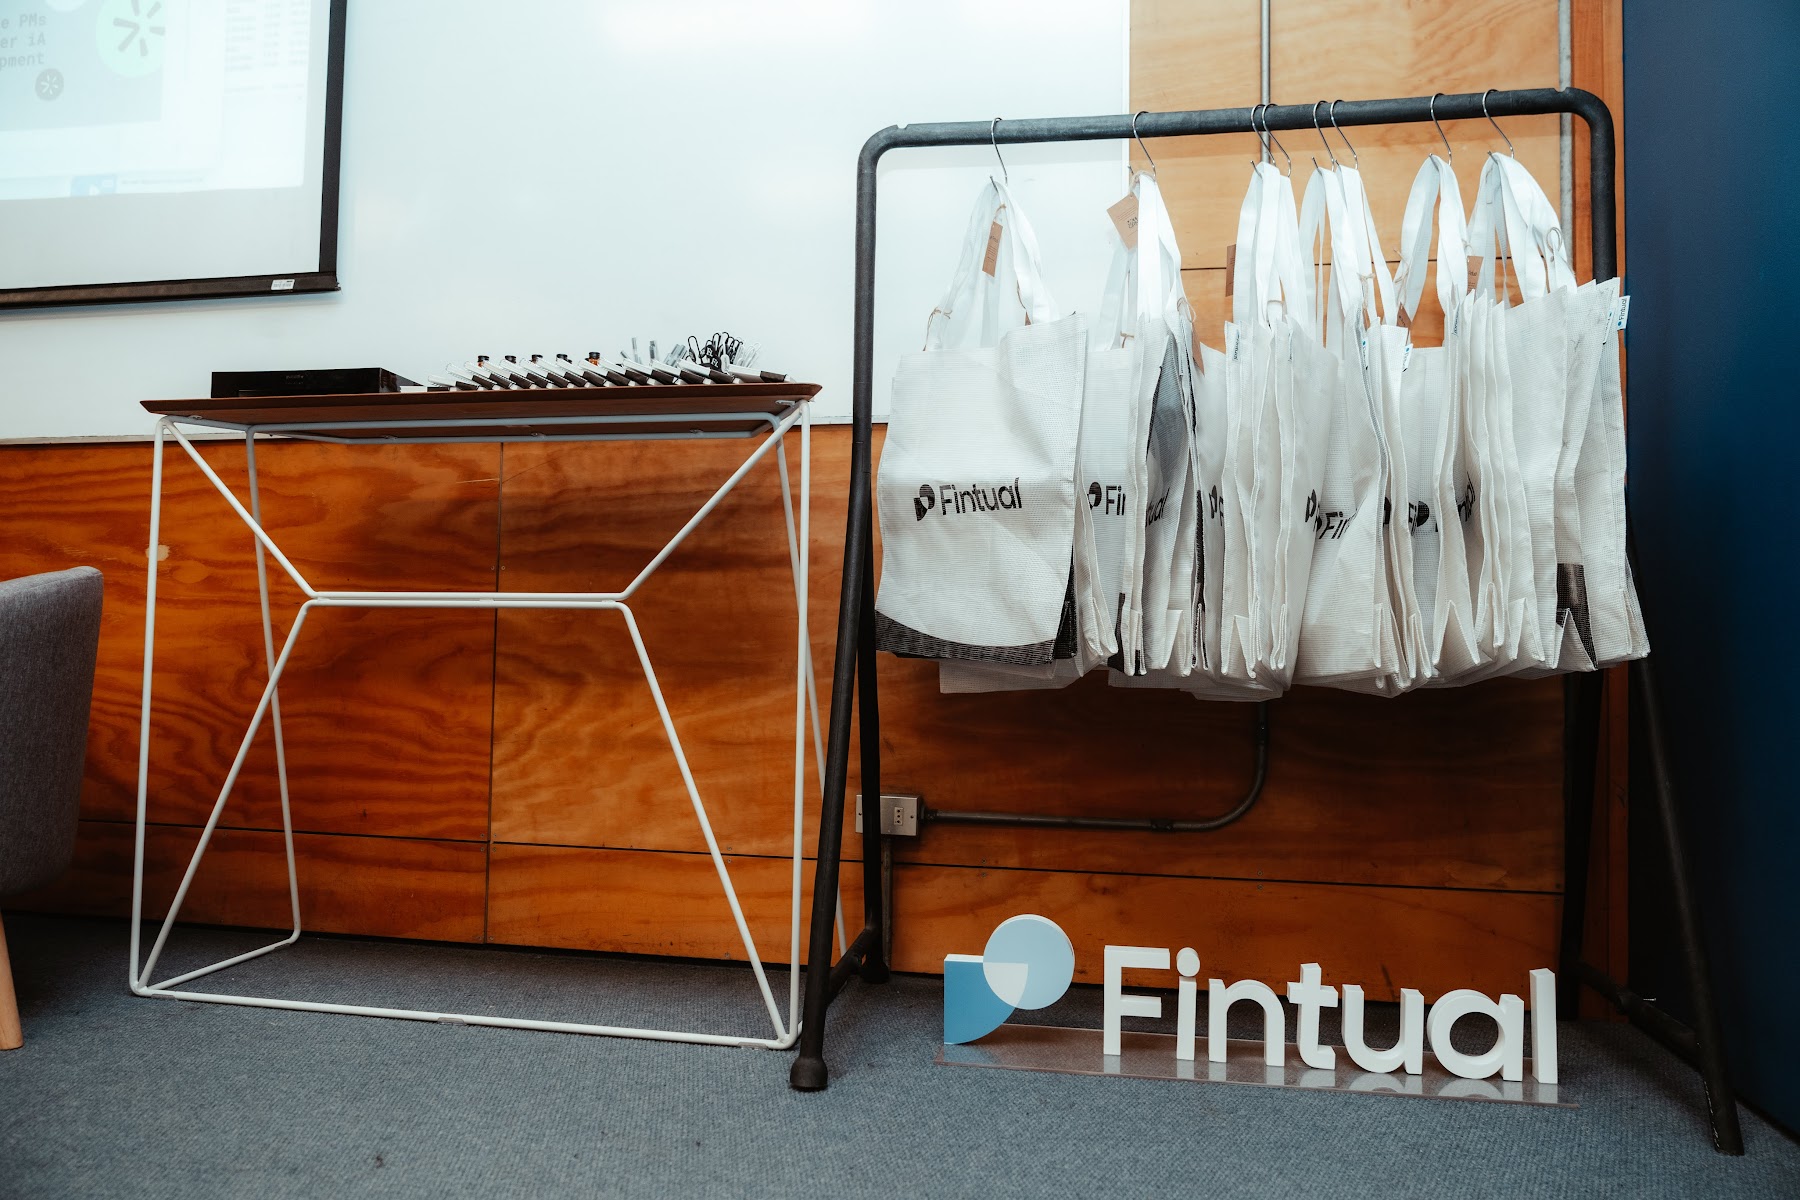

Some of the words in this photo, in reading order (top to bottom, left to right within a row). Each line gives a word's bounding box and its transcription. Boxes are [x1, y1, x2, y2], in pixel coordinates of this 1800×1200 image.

[19, 13, 47, 28] PMs
[939, 477, 1022, 516] Fintual
[1103, 944, 1558, 1085] Fintual
